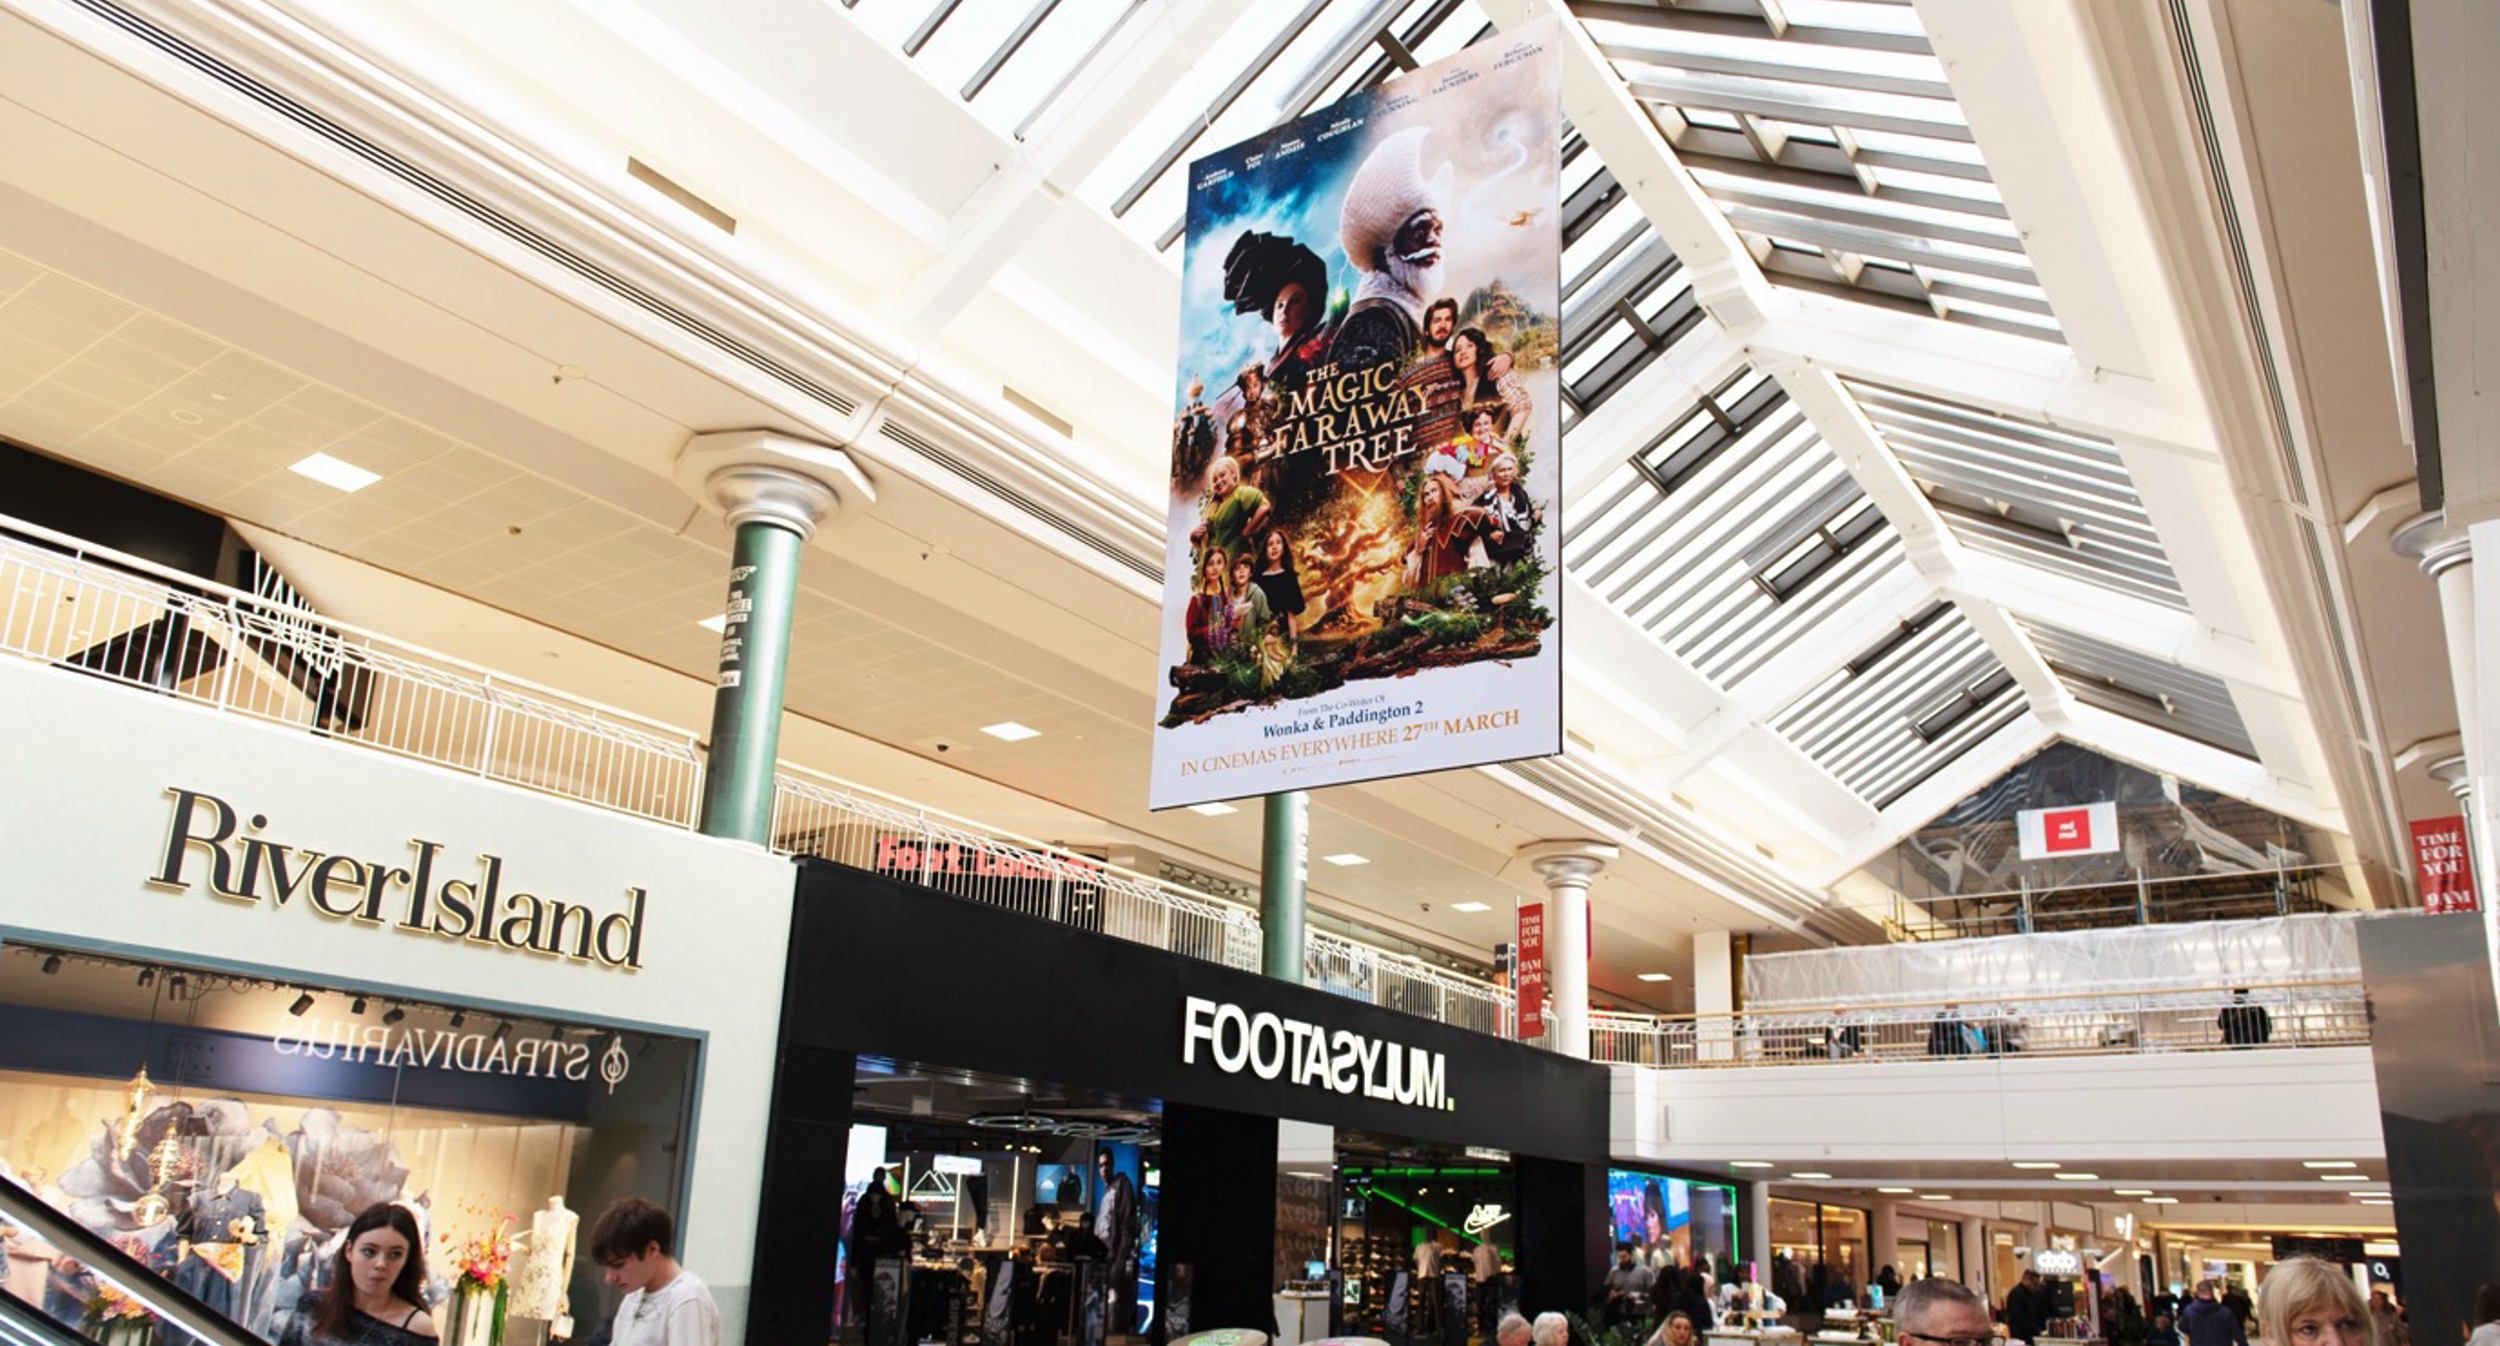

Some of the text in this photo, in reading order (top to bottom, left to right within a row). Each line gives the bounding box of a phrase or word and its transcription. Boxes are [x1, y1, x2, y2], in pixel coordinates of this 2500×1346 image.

[1306, 362, 1340, 384] THE
[1285, 361, 1400, 421] MAGIC
[1271, 383, 1434, 460] FARAWAY
[1322, 424, 1418, 477] TREE
[1298, 705, 1318, 717] From
[1320, 702, 1333, 712] The
[1375, 694, 1386, 704] Of
[1263, 700, 1424, 738] Wonka & Paddington 2
[1180, 760, 1199, 777] IN
[1202, 747, 1277, 772] CINEMAS
[1280, 727, 1398, 761] EVERYWHERE
[1443, 709, 1519, 736] MARCH
[2415, 830, 2462, 846] TIME
[2420, 844, 2464, 861] FOR
[2422, 860, 2464, 877] YOU
[2426, 890, 2472, 907] 9AM
[1520, 914, 1541, 926] TIME
[1521, 925, 1541, 937] FOR
[1522, 936, 1541, 949] YOU
